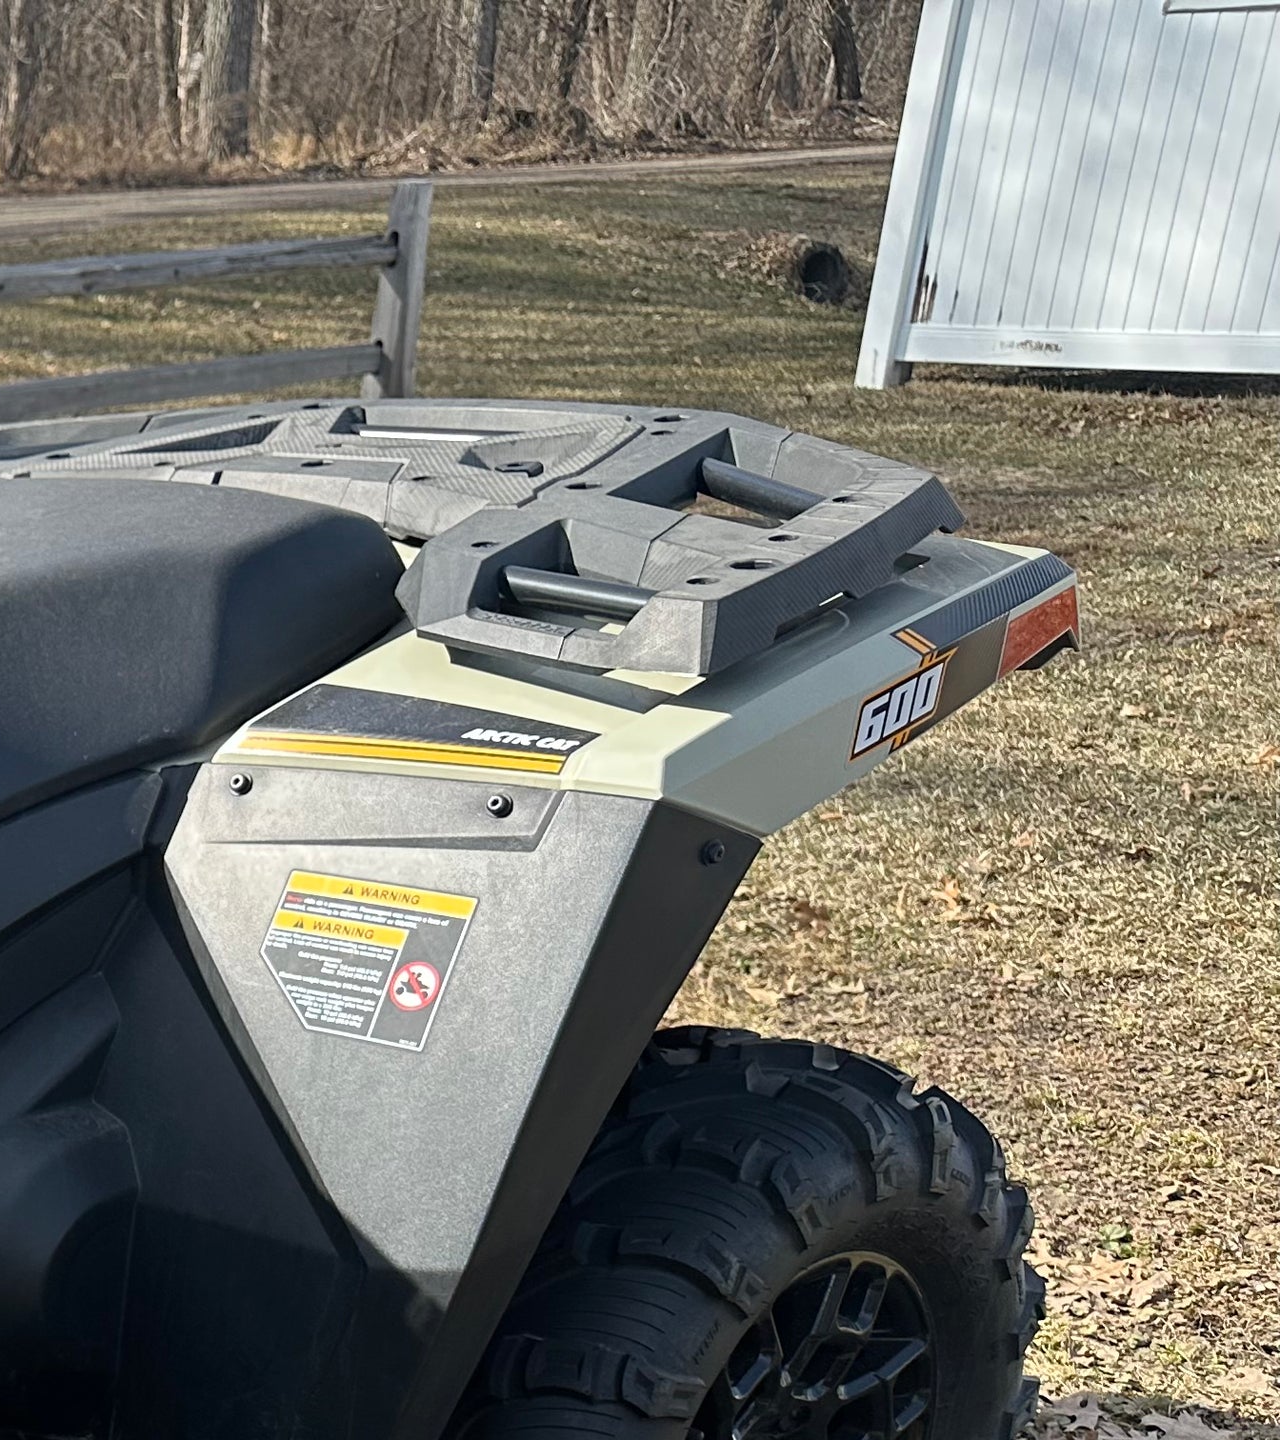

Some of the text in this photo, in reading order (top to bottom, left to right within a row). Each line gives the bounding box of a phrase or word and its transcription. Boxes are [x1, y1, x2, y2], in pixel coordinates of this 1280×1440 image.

[852, 661, 946, 757] 600
[461, 727, 582, 752] ARCTIC CAT
[360, 886, 421, 905] WARNING
[312, 921, 375, 940] WARNING
